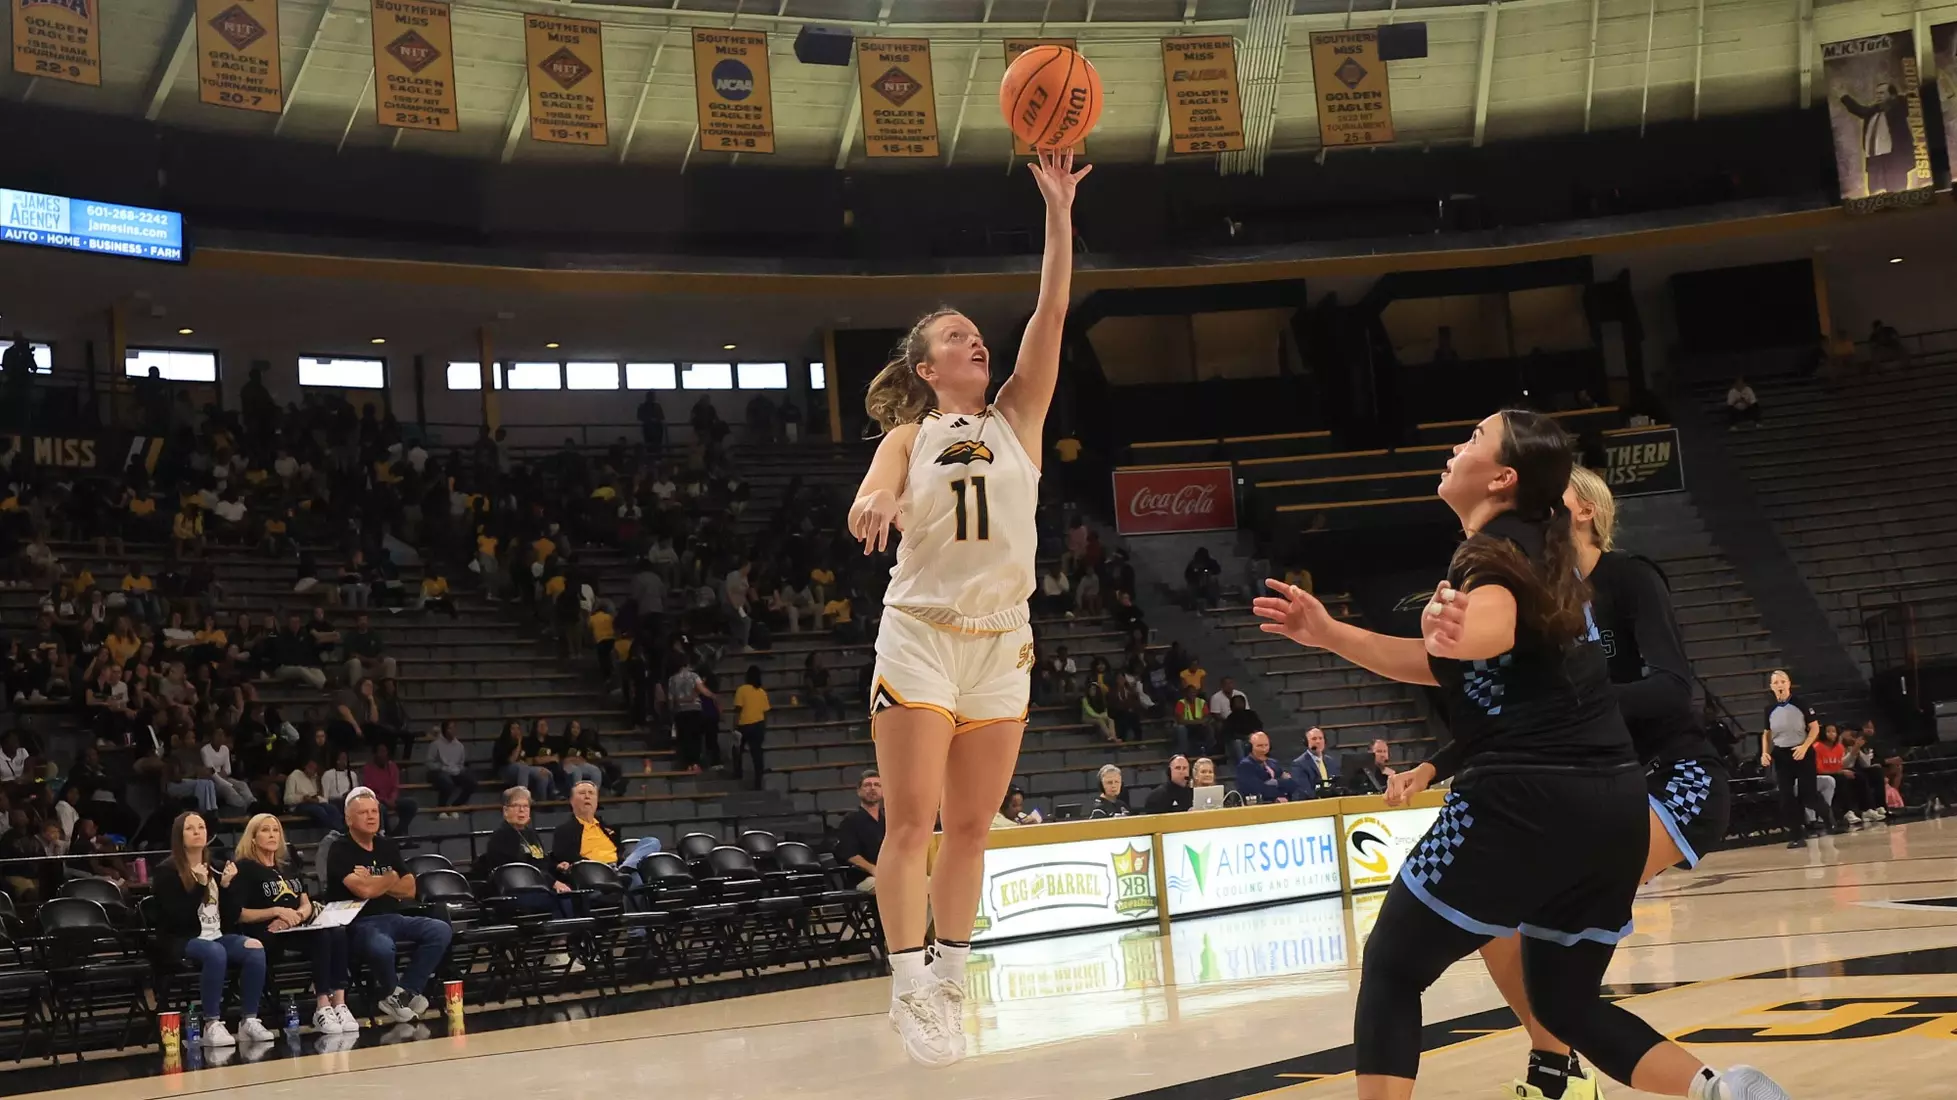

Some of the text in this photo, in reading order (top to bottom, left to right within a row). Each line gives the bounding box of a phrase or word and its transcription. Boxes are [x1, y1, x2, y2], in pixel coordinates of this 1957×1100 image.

[375, 1, 447, 17] SOUTHERN
[25, 16, 88, 37] GOLDEN
[395, 15, 429, 27] MISS
[528, 19, 598, 34] SOUTHERN
[223, 22, 254, 35] NIT
[28, 27, 87, 44] EAGLES
[547, 32, 580, 44] MISS
[696, 33, 764, 45] SOUTHERN
[860, 42, 927, 52] SOUTHERN
[1166, 41, 1231, 52] SOUTHERN
[1333, 45, 1363, 55] MISS
[1859, 36, 1891, 53] Turk
[400, 46, 429, 58] NIT
[715, 46, 747, 56] MISS
[1183, 52, 1214, 60] MISS
[208, 51, 269, 66] GOLDEN
[879, 54, 910, 62] MISS
[35, 60, 80, 77] 22-9
[211, 60, 269, 75] EAGLES
[552, 63, 579, 74] NIT
[201, 77, 279, 95] TOURNAMENT
[387, 74, 444, 88] GOLDEN
[716, 79, 753, 91] NCAA
[884, 82, 911, 91] NIT
[389, 84, 443, 96] EAGLES
[1176, 90, 1229, 98] GOLDEN
[1325, 90, 1382, 102] GOLDEN
[219, 91, 262, 106] 20-7
[423, 98, 440, 106] NIT
[539, 91, 594, 103] GOLDEN
[1180, 97, 1229, 106] EAGLES
[384, 101, 450, 114] CHAMPIONS
[541, 100, 594, 111] EAGLES
[708, 102, 762, 112] GOLDEN
[1327, 102, 1382, 113] EAGLES
[395, 112, 440, 126] 23-11
[711, 111, 762, 120] EAGLES
[873, 109, 926, 117] GOLDEN
[1046, 87, 1088, 146] Wilson
[1902, 57, 1932, 179] SOUTHERN MISS
[1326, 121, 1387, 132] TOURNAMENT
[702, 129, 772, 138] TOURNAMENT
[1343, 131, 1373, 143] 25-8
[720, 137, 756, 147] 21-8
[20, 194, 60, 213] JAMES
[10, 202, 60, 229] AGENCY
[86, 205, 168, 226] 601-268-2242
[88, 219, 168, 240] jamesins.com
[5, 229, 181, 259] AUTO HOME BUSINESS FARM
[33, 436, 97, 468] MISS
[1130, 484, 1218, 517] Coca-Cola
[950, 474, 989, 542] 11
[1216, 834, 1334, 877] AIRSOUTH
[1000, 878, 1029, 907] KEG
[1046, 872, 1102, 897] BARREL
[1216, 881, 1264, 899] COOLING
[1269, 877, 1289, 891] AND
[1295, 871, 1339, 886] HEATING
